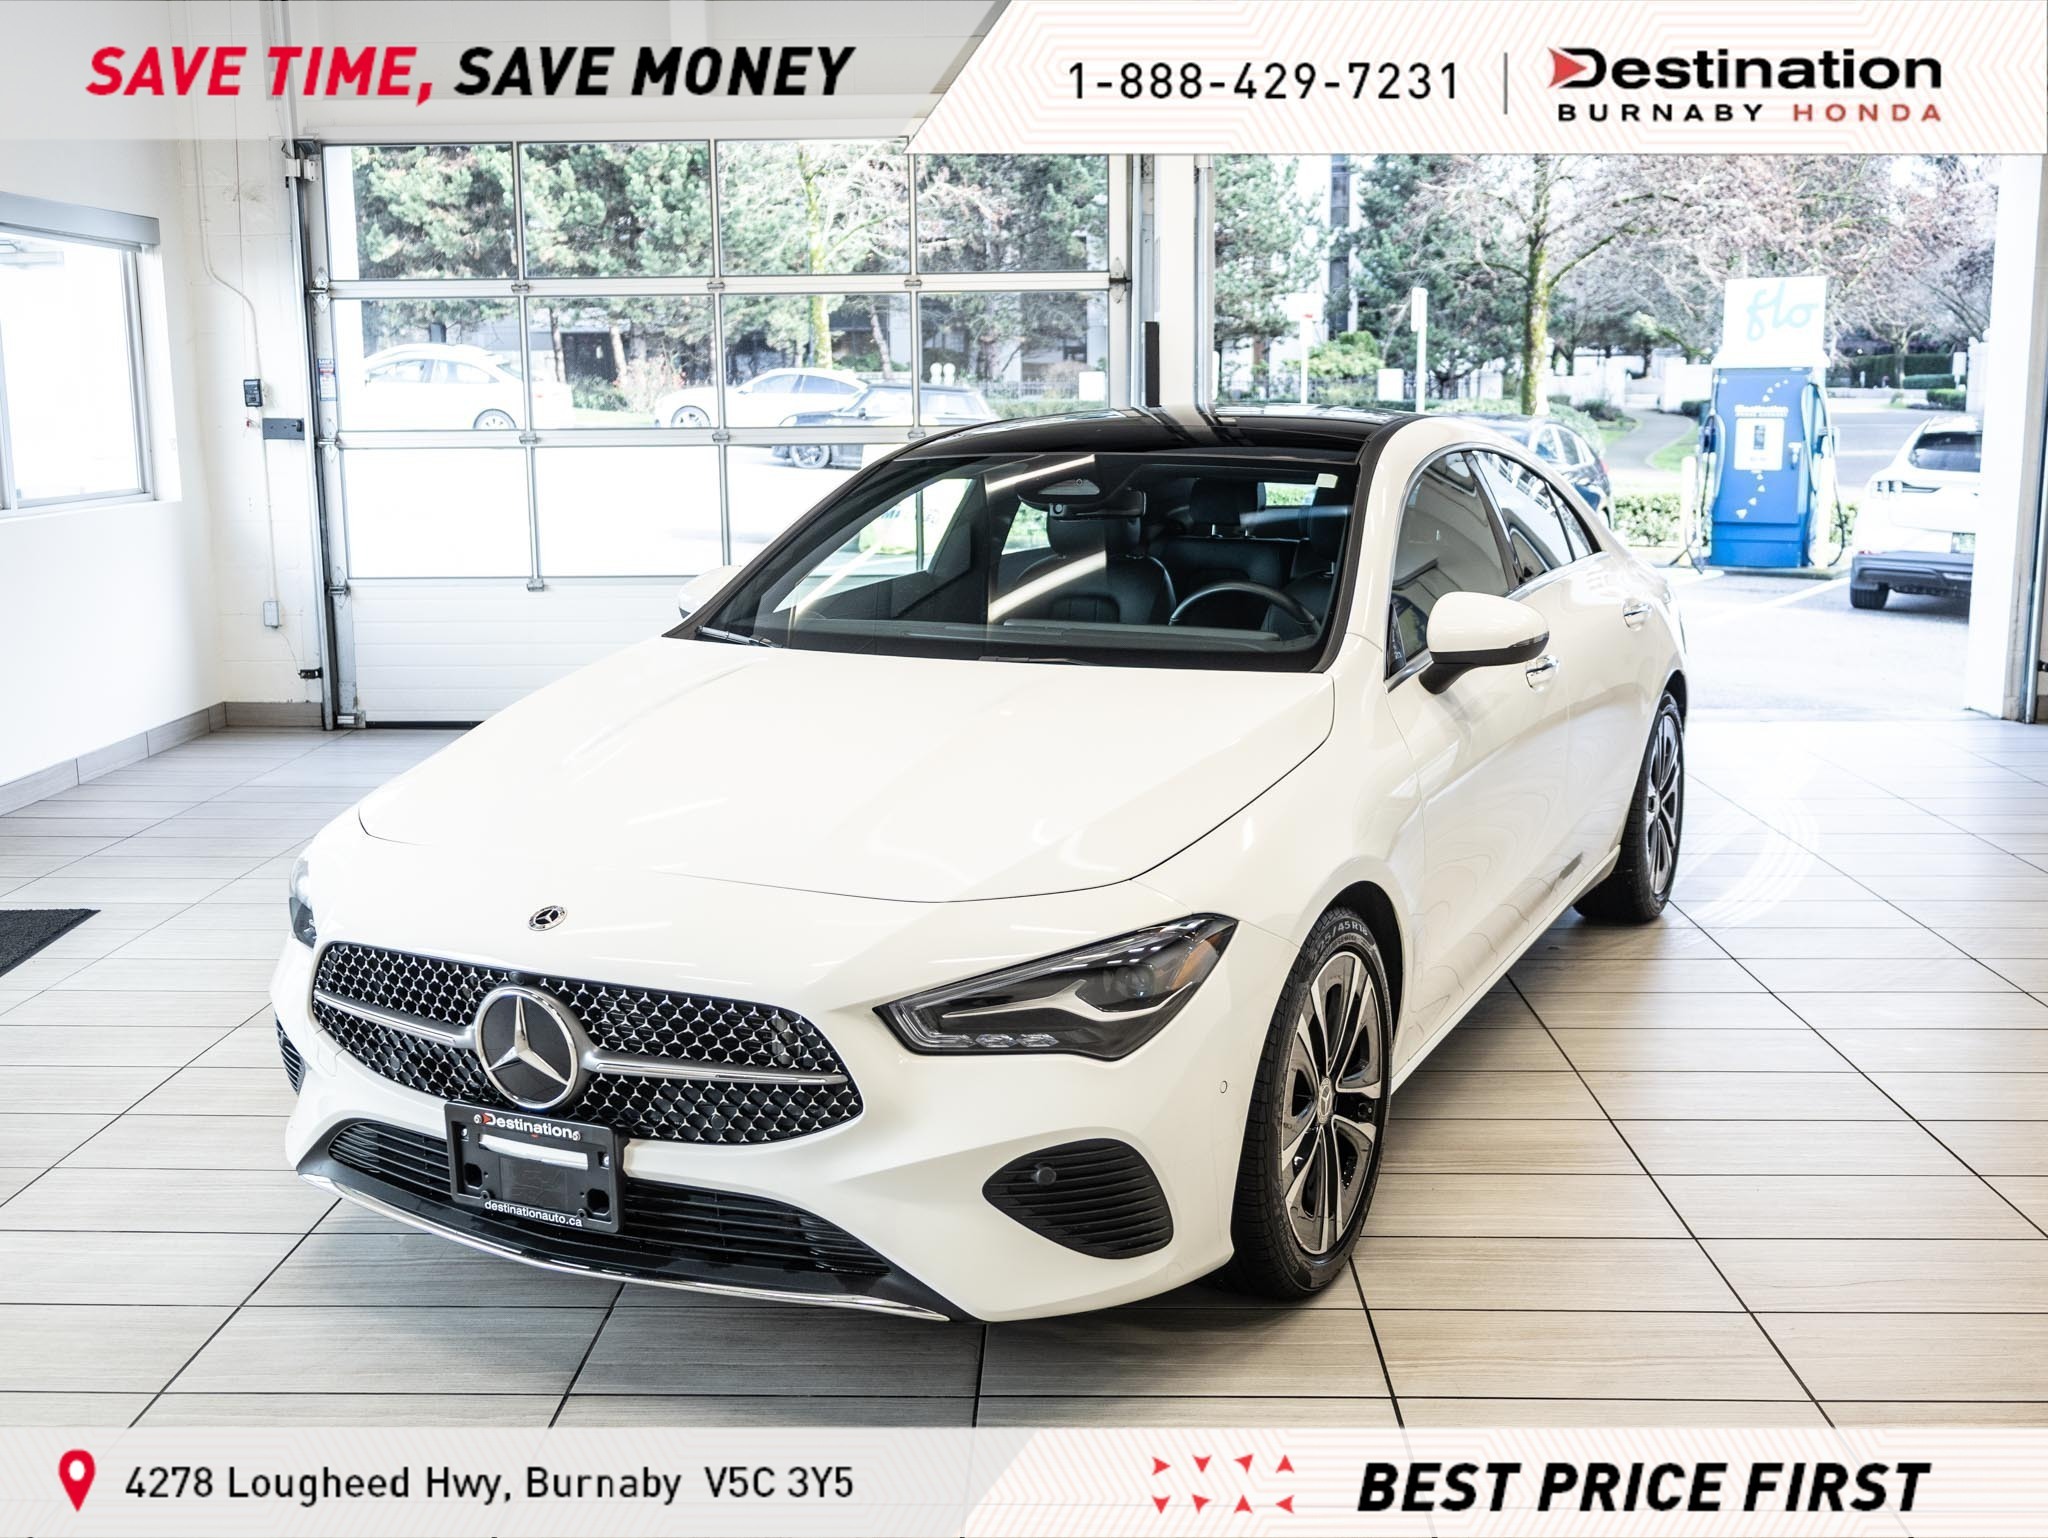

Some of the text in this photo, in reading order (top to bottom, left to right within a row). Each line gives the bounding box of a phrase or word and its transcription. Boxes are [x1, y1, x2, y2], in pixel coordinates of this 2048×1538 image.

[1746, 281, 1819, 342] flo
[482, 1112, 574, 1140] Destination
[484, 1200, 583, 1228] destinationauto.ca
